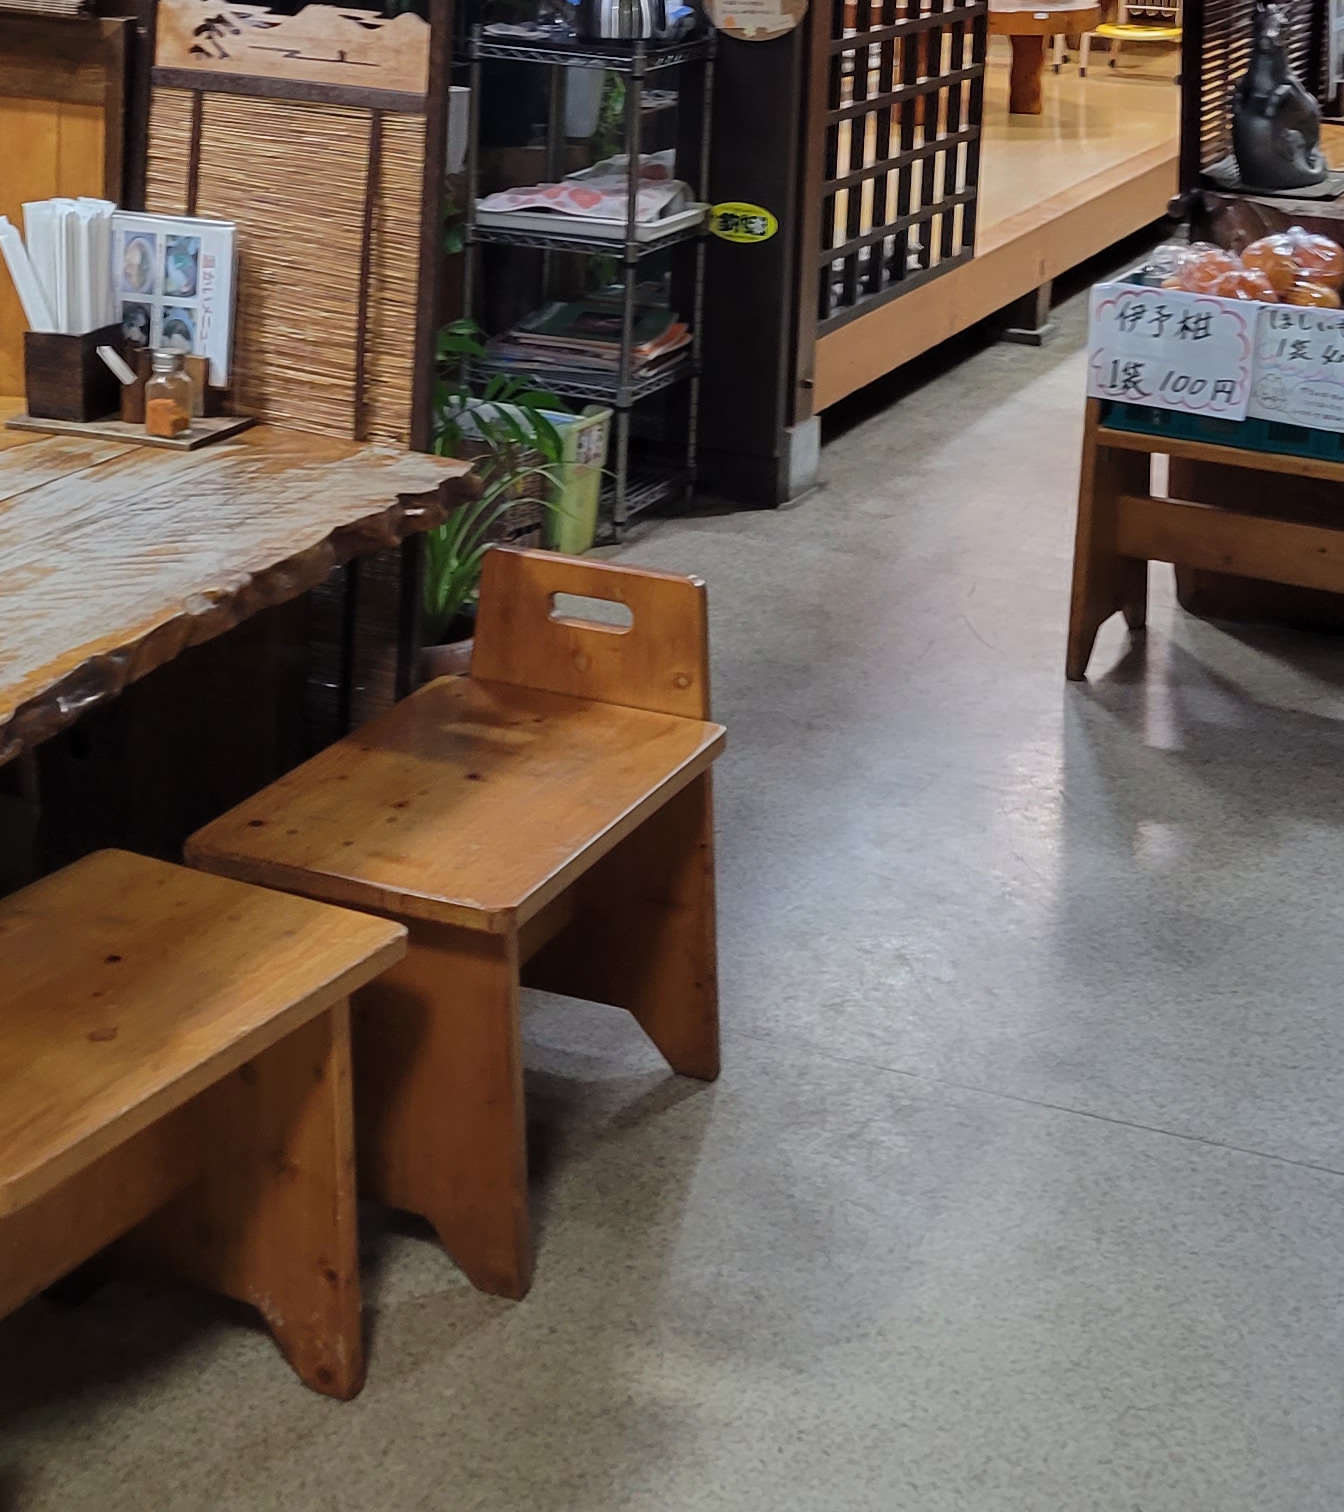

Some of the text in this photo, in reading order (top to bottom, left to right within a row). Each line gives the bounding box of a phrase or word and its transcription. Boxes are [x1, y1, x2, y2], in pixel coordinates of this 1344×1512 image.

[1115, 301, 1215, 340] 伊予柑
[1109, 359, 1236, 403] 1袋 100円
